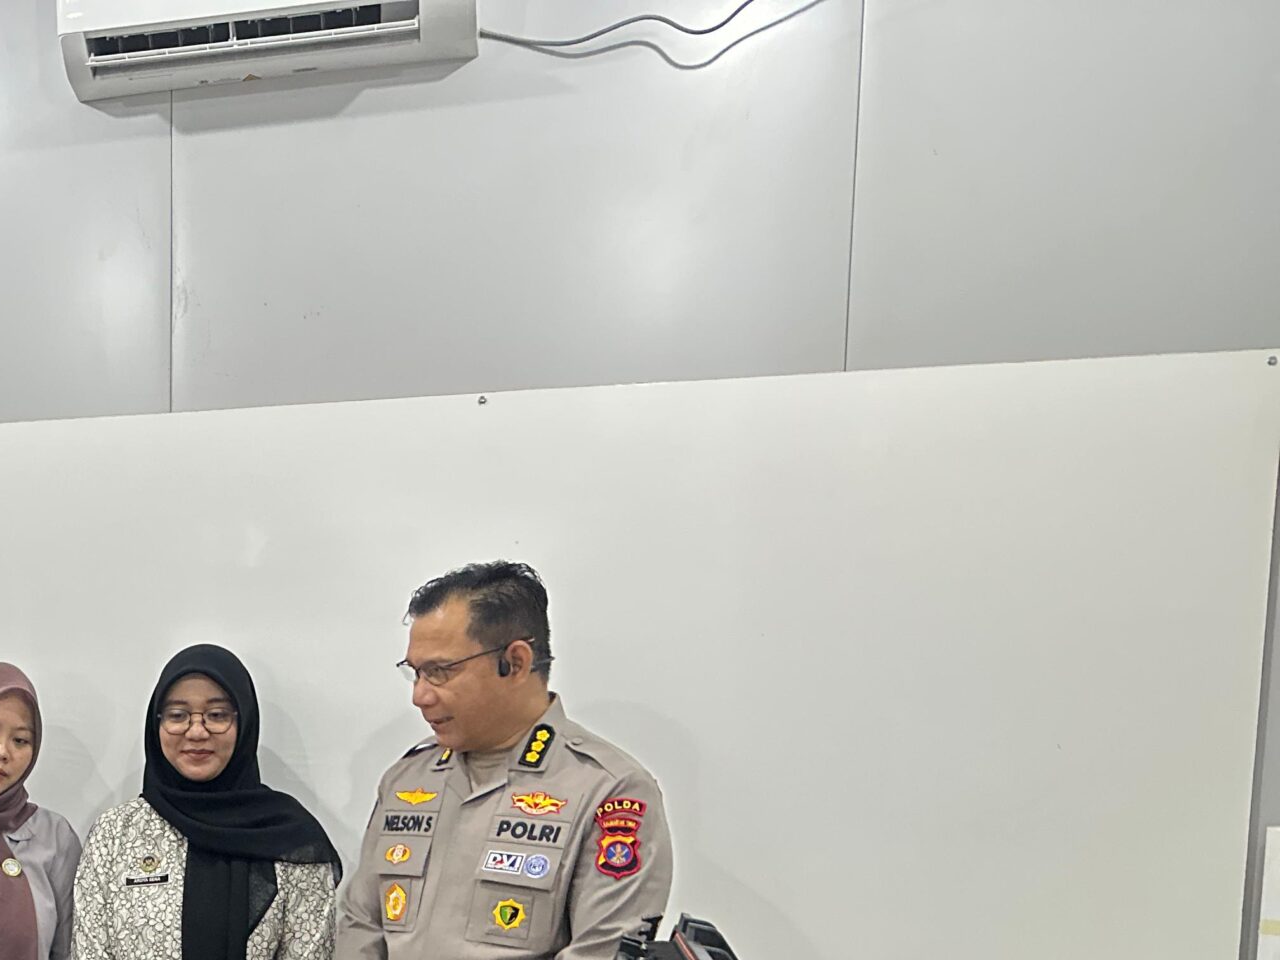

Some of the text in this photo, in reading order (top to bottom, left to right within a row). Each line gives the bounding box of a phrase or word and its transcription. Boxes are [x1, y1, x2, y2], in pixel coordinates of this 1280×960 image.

[596, 800, 640, 817] POLDA
[383, 815, 433, 832] NELSON S
[496, 820, 561, 843] POLRI
